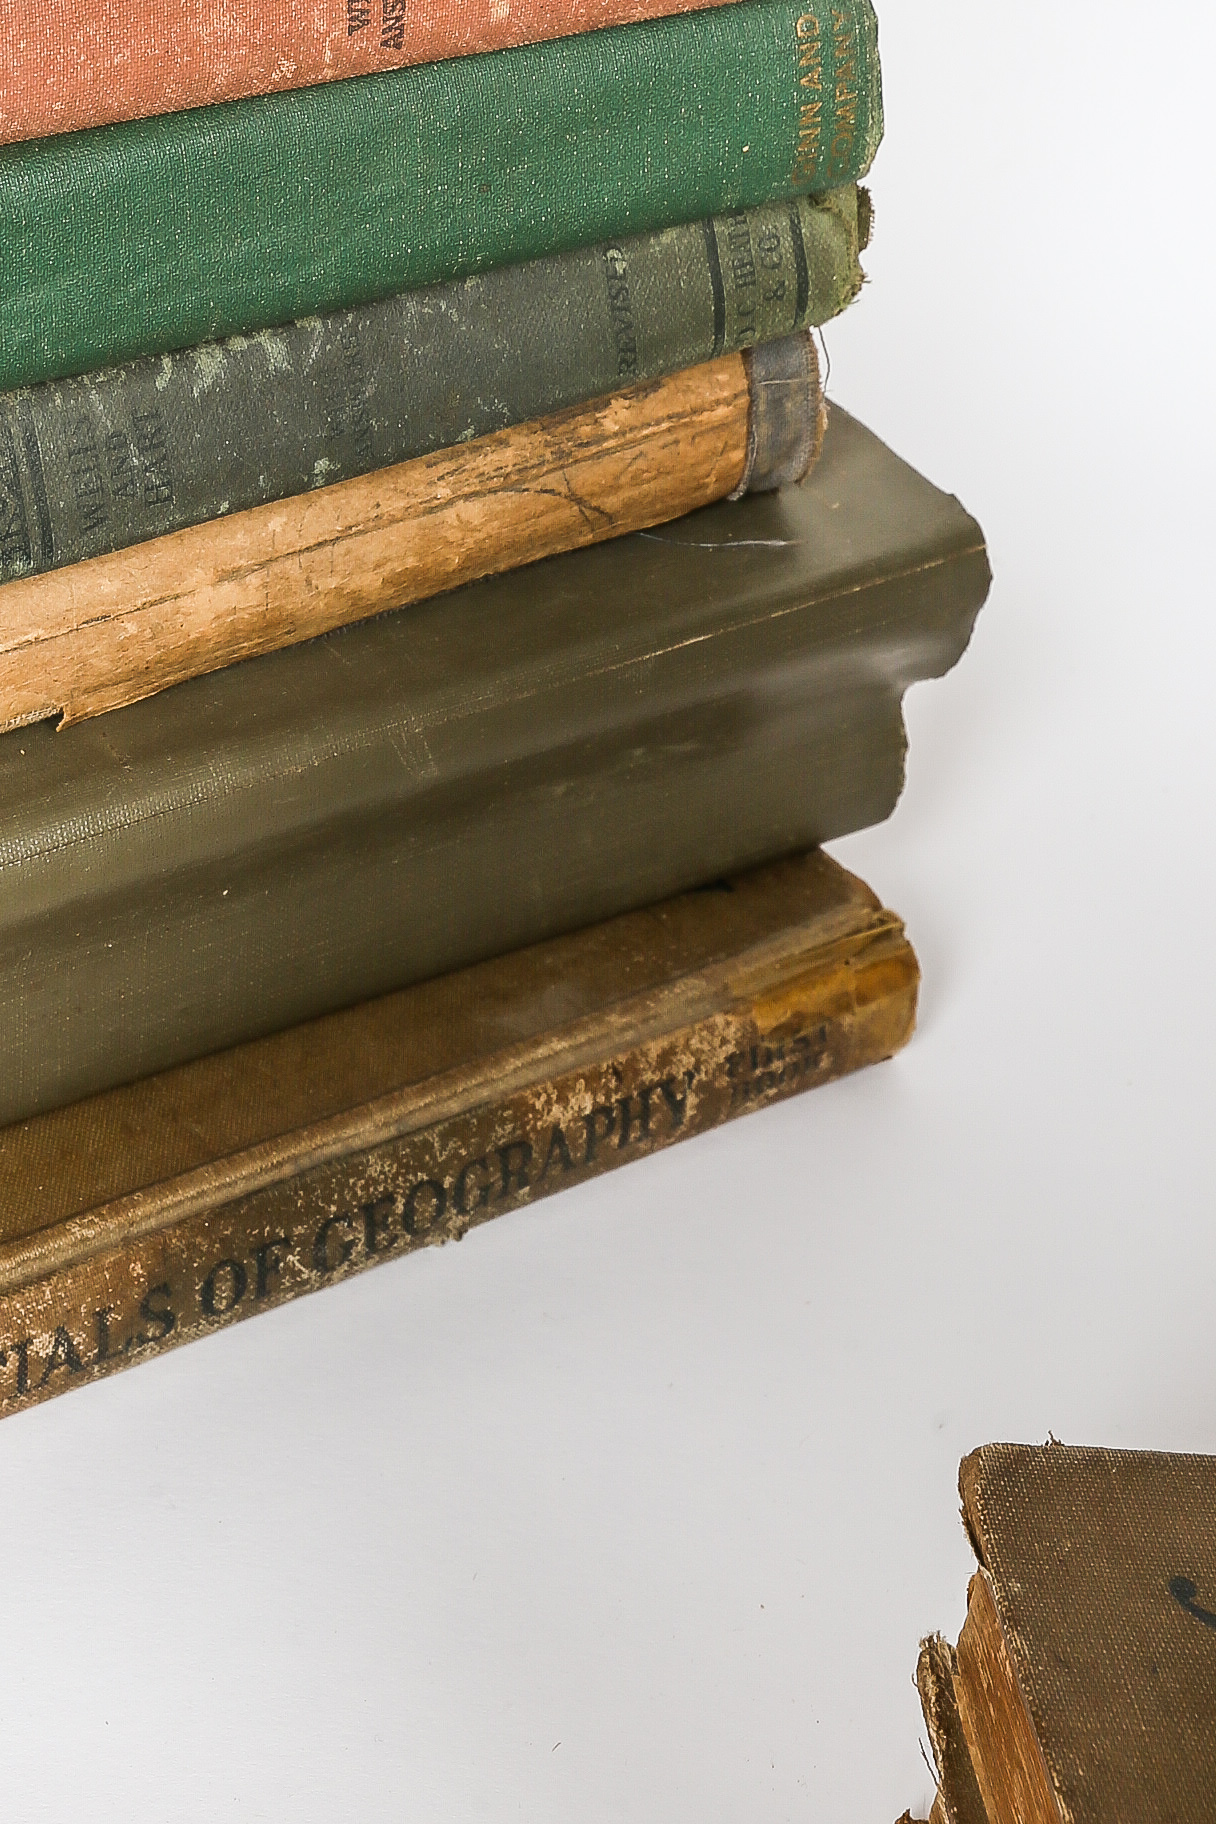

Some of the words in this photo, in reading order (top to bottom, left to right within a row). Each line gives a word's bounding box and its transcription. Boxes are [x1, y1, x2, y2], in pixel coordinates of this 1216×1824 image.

[795, 14, 824, 90] AND
[827, 9, 860, 179] COMPANY
[792, 102, 824, 185] GINN
[199, 1235, 291, 1317] OF
[312, 1069, 700, 1273] GEOGRAPHY
